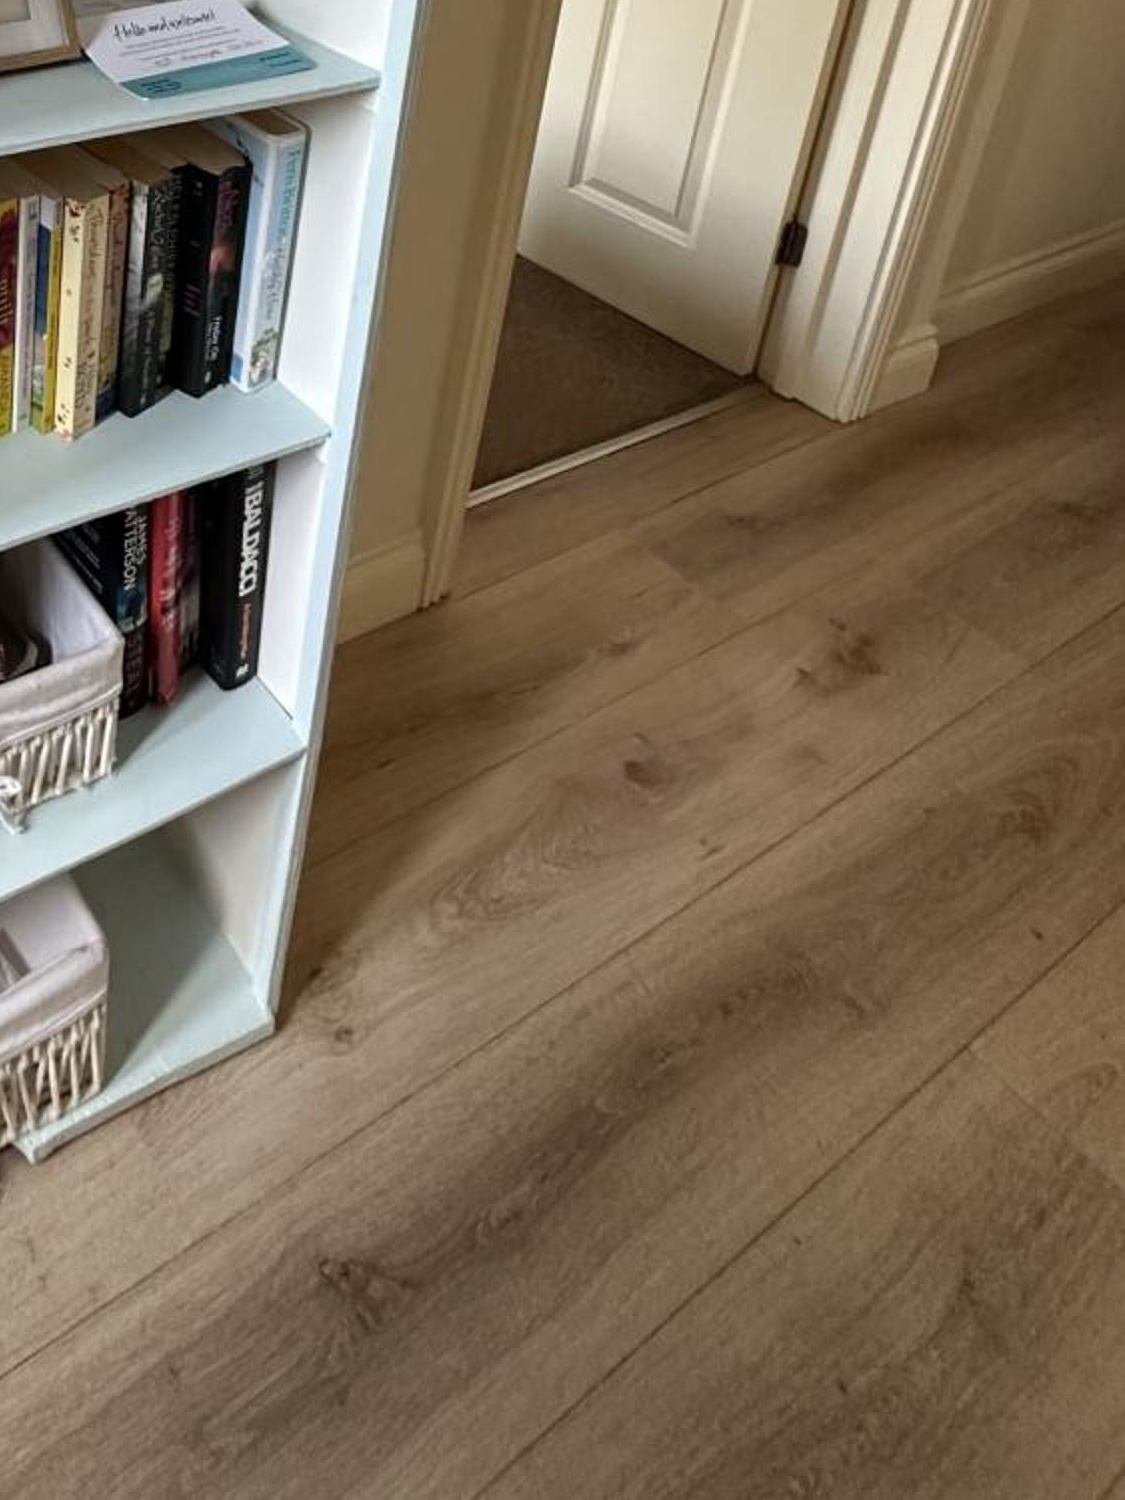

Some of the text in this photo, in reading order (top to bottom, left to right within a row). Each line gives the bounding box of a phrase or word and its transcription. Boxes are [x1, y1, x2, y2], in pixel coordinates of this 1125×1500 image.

[122, 510, 137, 591] ATTERSON
[135, 516, 148, 565] JAMES
[238, 489, 263, 597] BALDACCI
